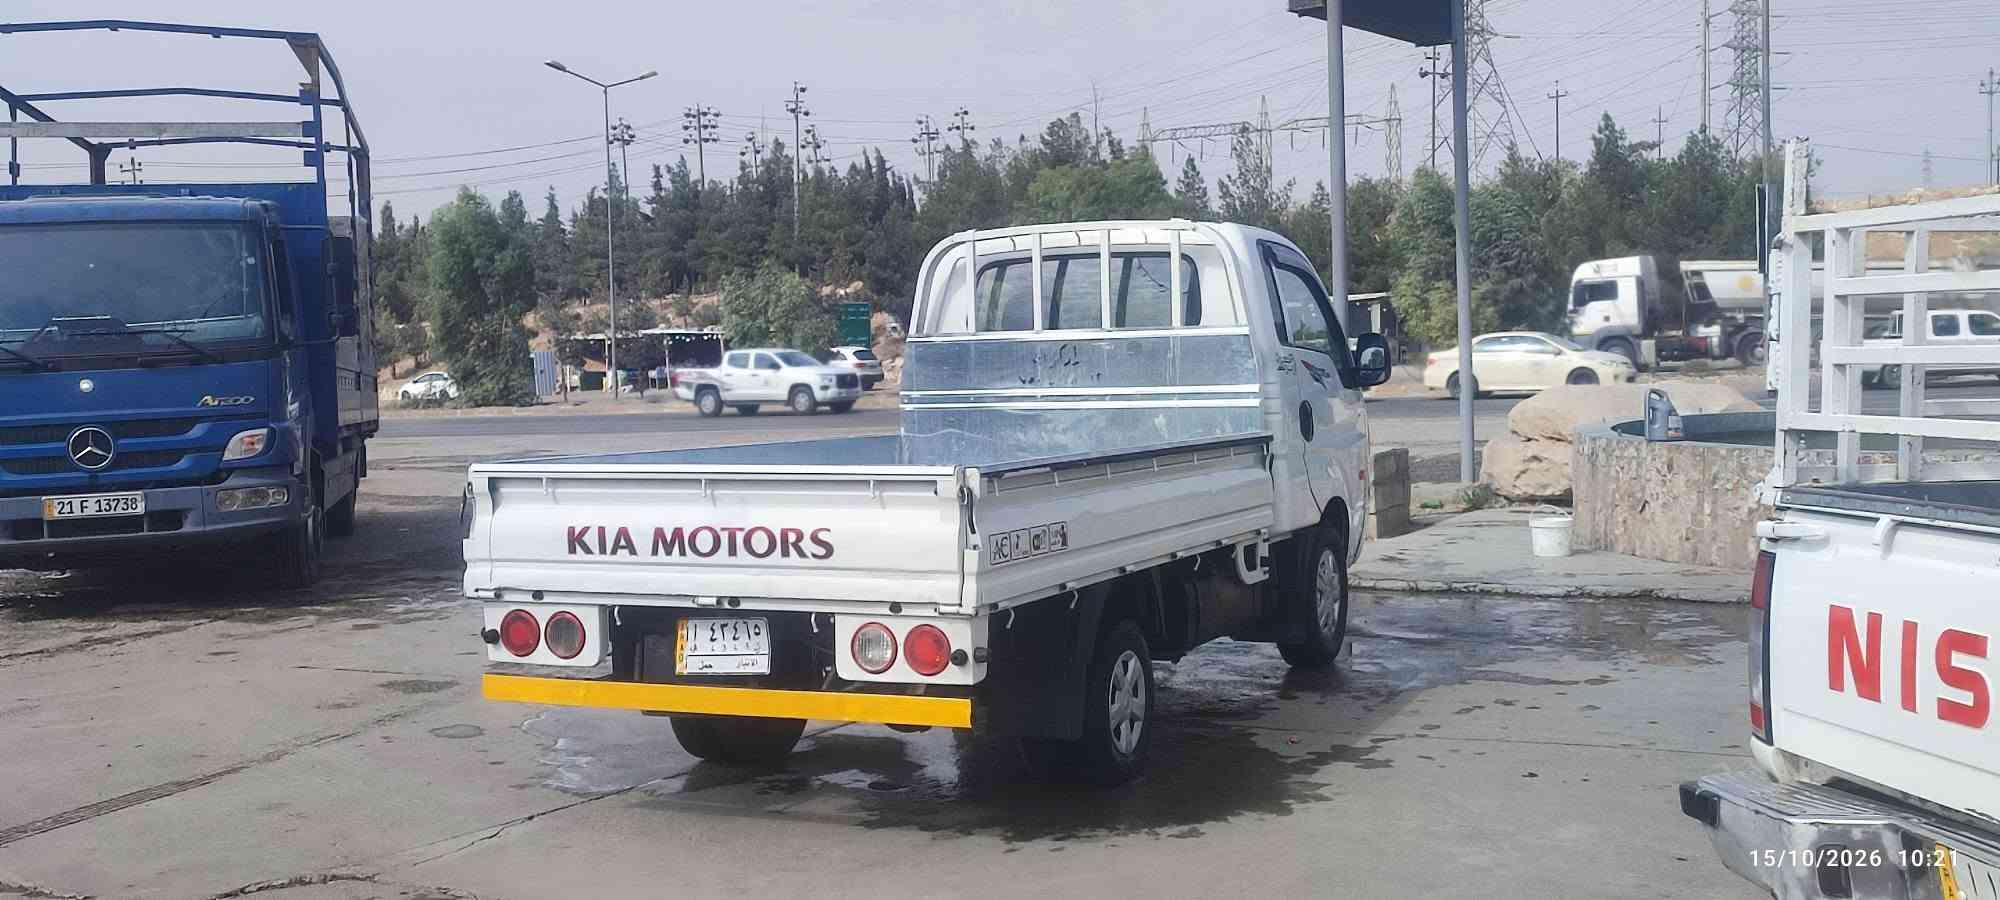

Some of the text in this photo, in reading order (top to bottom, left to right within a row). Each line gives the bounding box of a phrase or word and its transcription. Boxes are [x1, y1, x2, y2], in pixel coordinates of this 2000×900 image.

[57, 500, 74, 515] 21
[80, 499, 89, 514] F
[94, 497, 138, 513] 13738
[567, 525, 835, 560] KIA MOTORS
